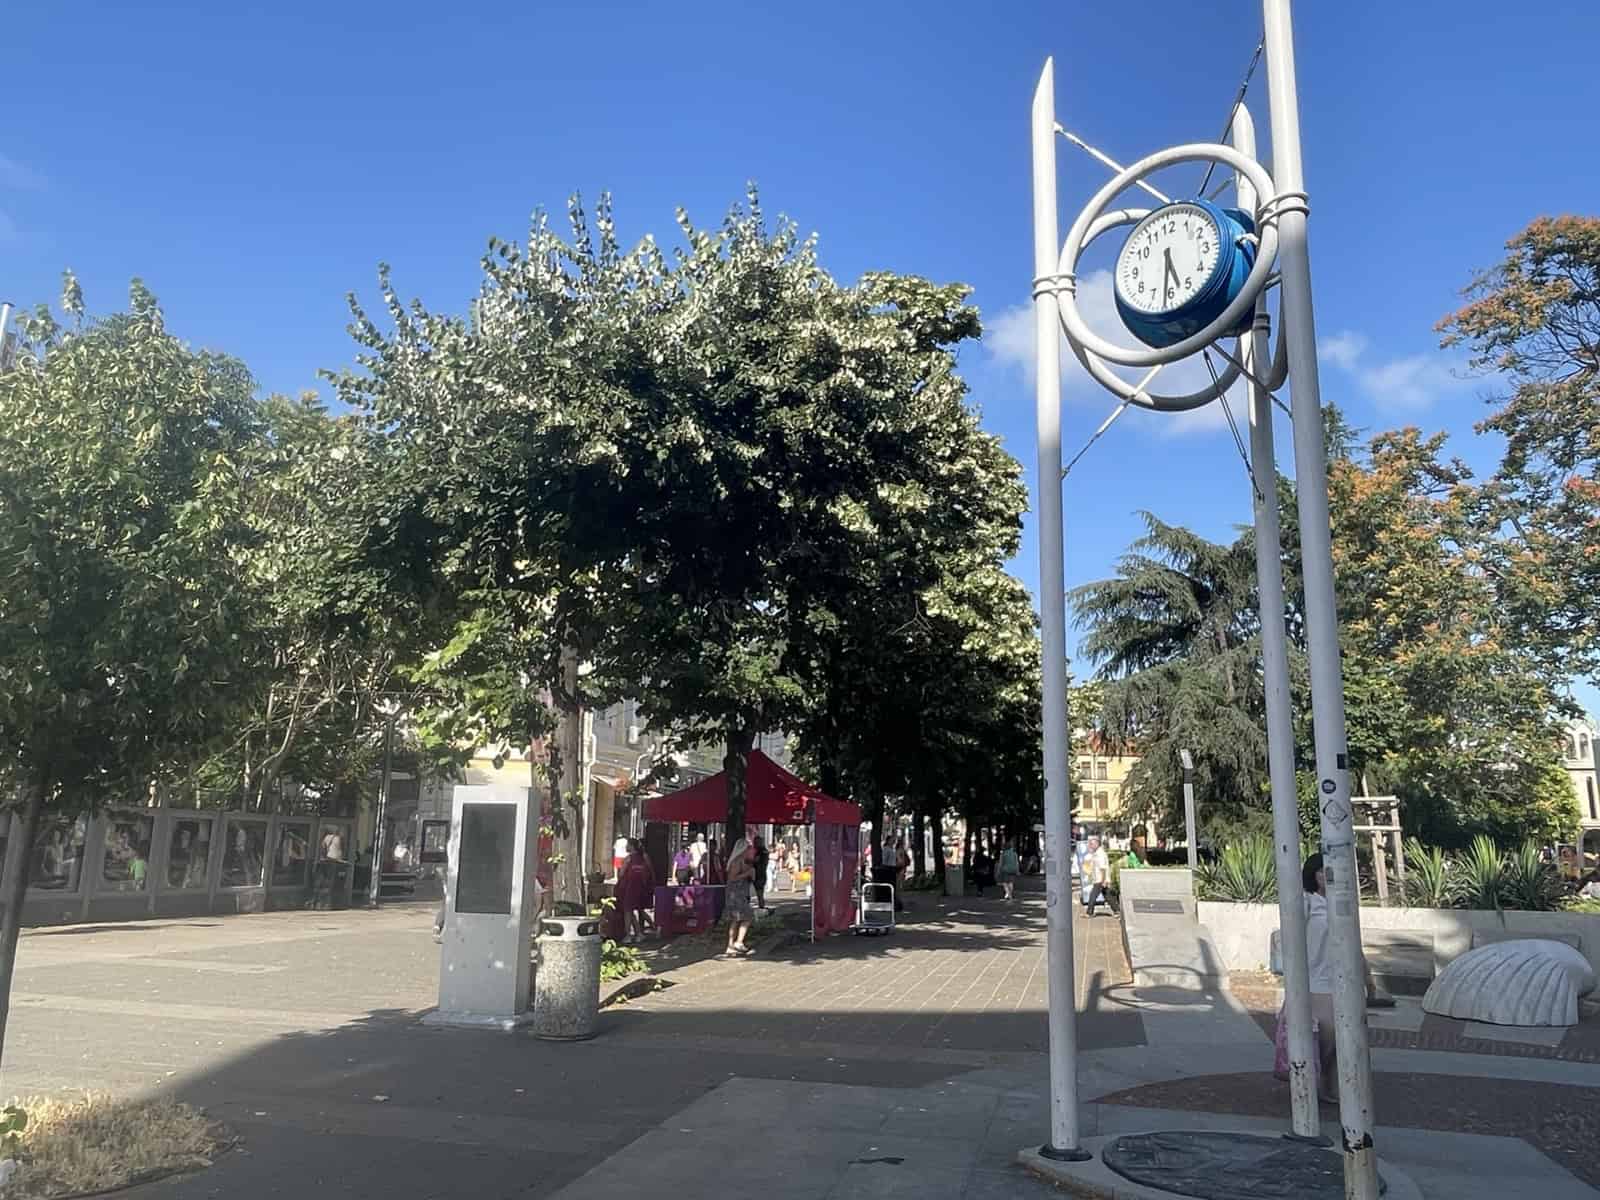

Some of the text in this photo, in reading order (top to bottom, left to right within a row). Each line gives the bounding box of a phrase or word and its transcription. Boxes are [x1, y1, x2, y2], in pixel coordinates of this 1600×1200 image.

[1161, 221, 1176, 235] 12
[1184, 221, 1189, 232] 1
[1147, 232, 1158, 245] 11
[1196, 227, 1203, 240] 2
[1137, 246, 1150, 261] 10
[1202, 242, 1210, 254] 3
[1196, 261, 1204, 272] 4
[1132, 267, 1138, 279] 9
[1138, 282, 1145, 294] 8
[1185, 277, 1192, 290] 5
[1150, 288, 1157, 300] 7
[1168, 288, 1175, 300] 6
